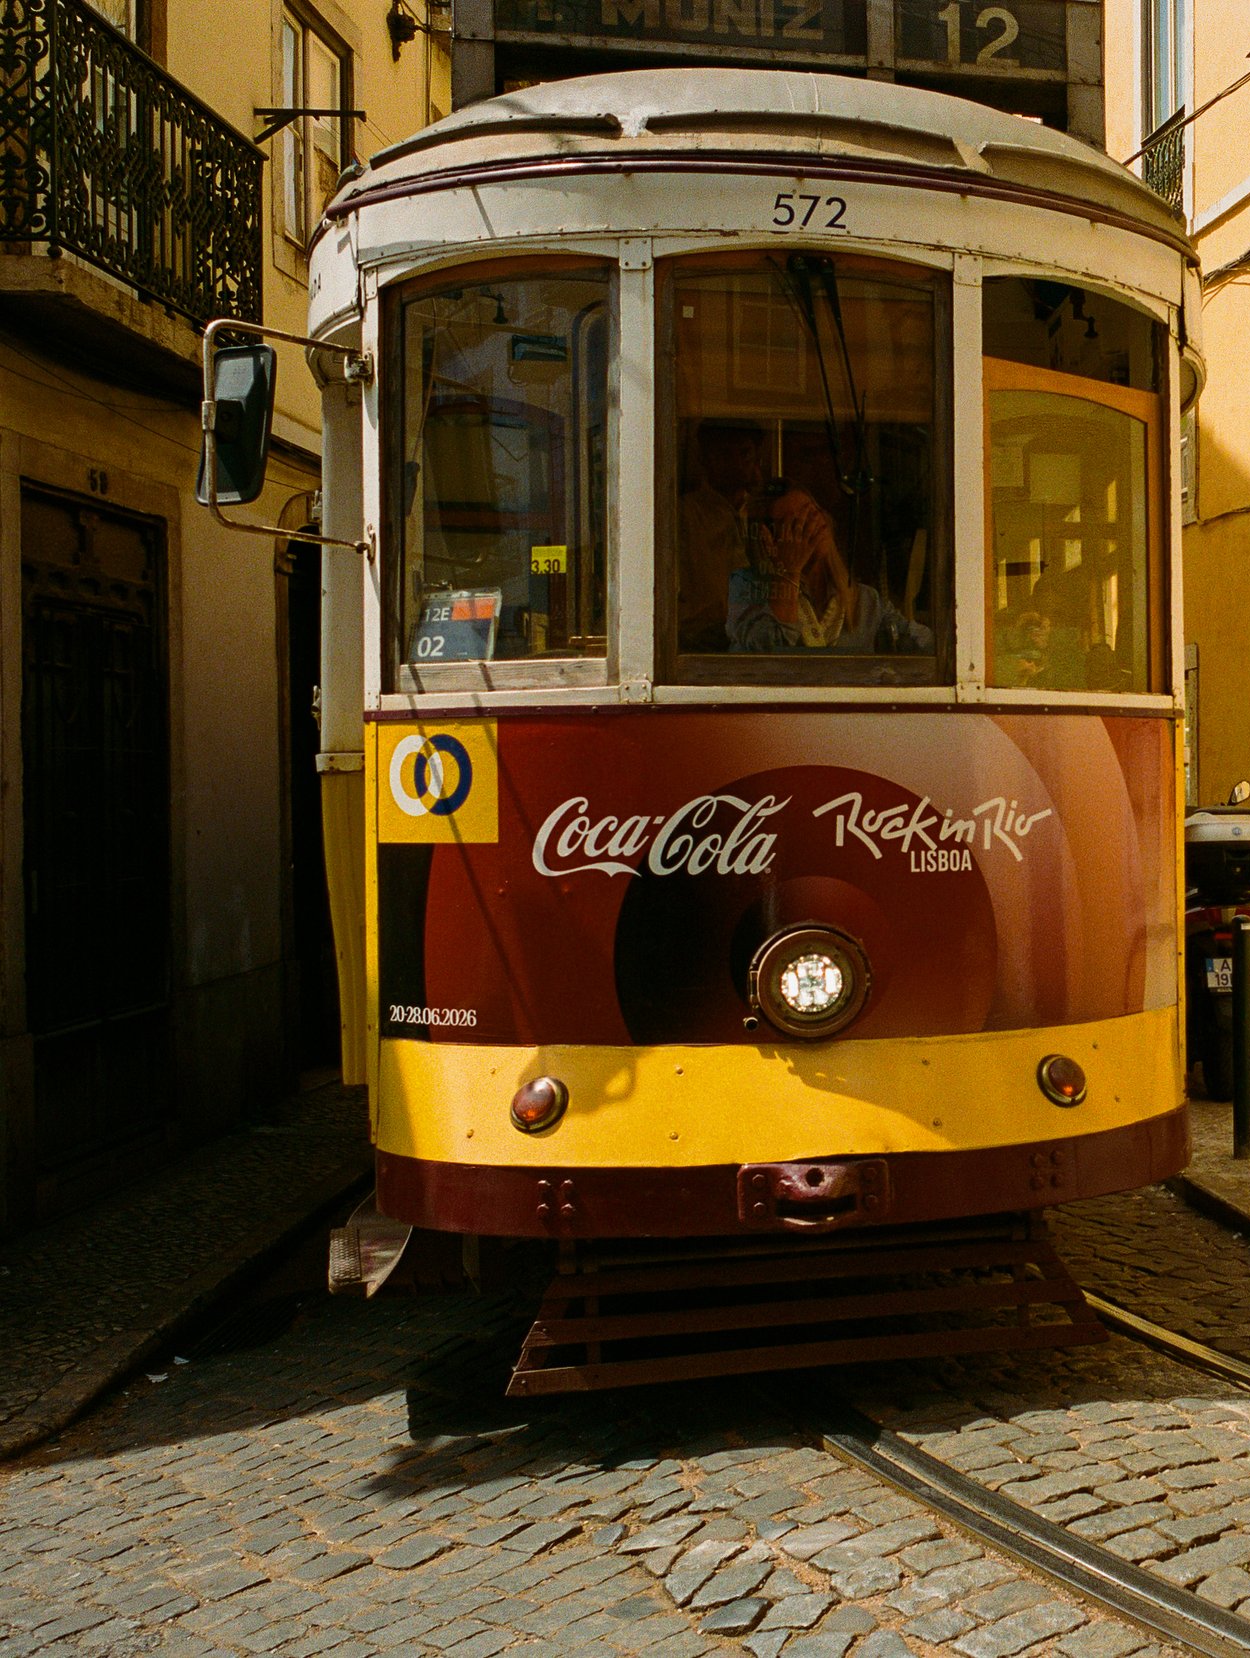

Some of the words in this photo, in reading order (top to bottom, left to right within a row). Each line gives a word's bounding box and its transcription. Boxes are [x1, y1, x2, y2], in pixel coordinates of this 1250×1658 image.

[937, 1, 1021, 67] 12
[772, 193, 847, 230] 572
[424, 607, 450, 622] 12E
[417, 635, 445, 658] 02
[532, 795, 793, 878] Coca-Cola
[812, 792, 938, 860] Rock
[939, 808, 976, 843] in
[973, 796, 1053, 862] Rio
[910, 849, 973, 873] LISBOA
[1215, 973, 1232, 986] 19
[389, 1004, 477, 1027] 20-28.06.2026
